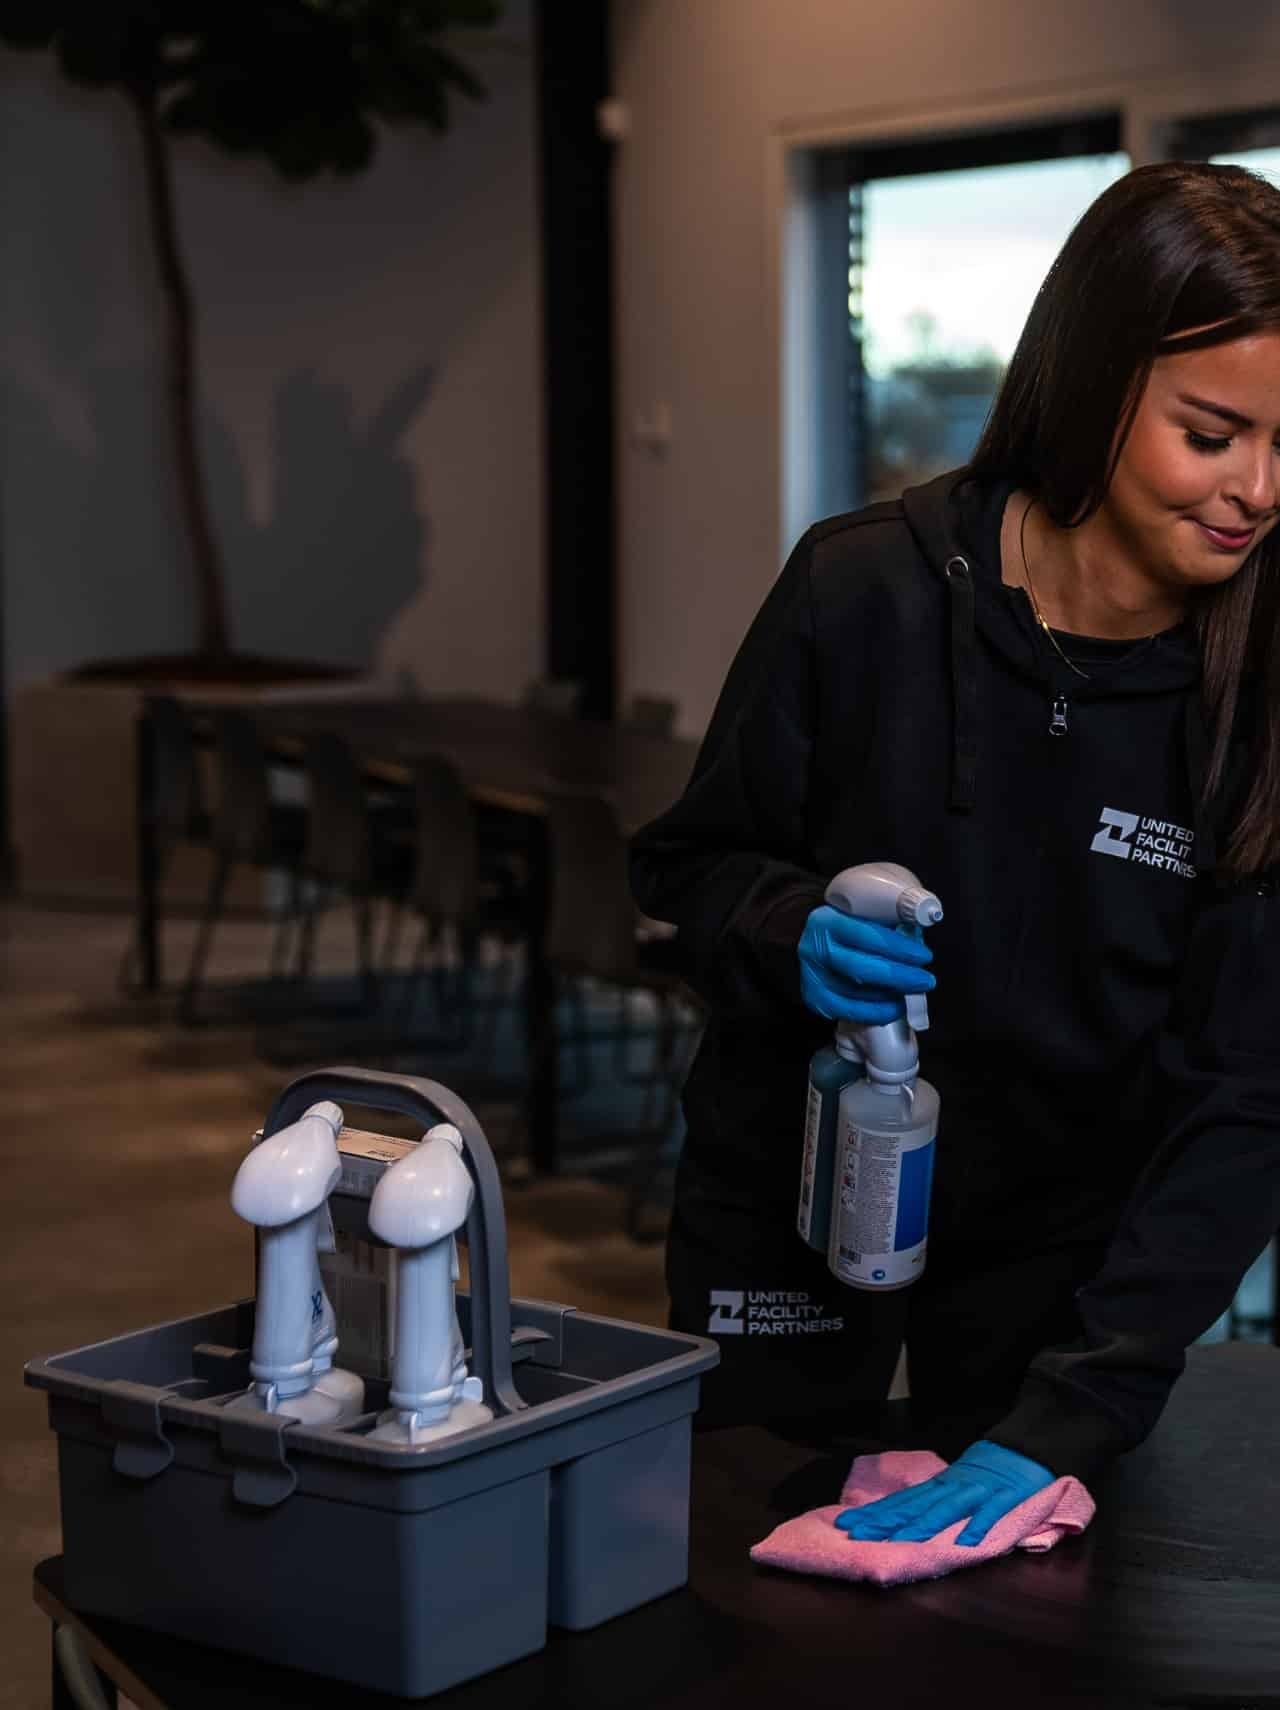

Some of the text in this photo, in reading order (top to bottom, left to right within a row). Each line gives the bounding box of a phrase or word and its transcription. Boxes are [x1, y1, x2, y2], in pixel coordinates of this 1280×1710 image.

[1141, 816, 1195, 842] UNITED
[1135, 832, 1193, 859] FACILIT
[1131, 847, 1198, 879] PARTNRS
[747, 1290, 809, 1304] UNITED
[747, 1304, 824, 1319] FACILITY
[747, 1317, 844, 1335] PARTNERS
